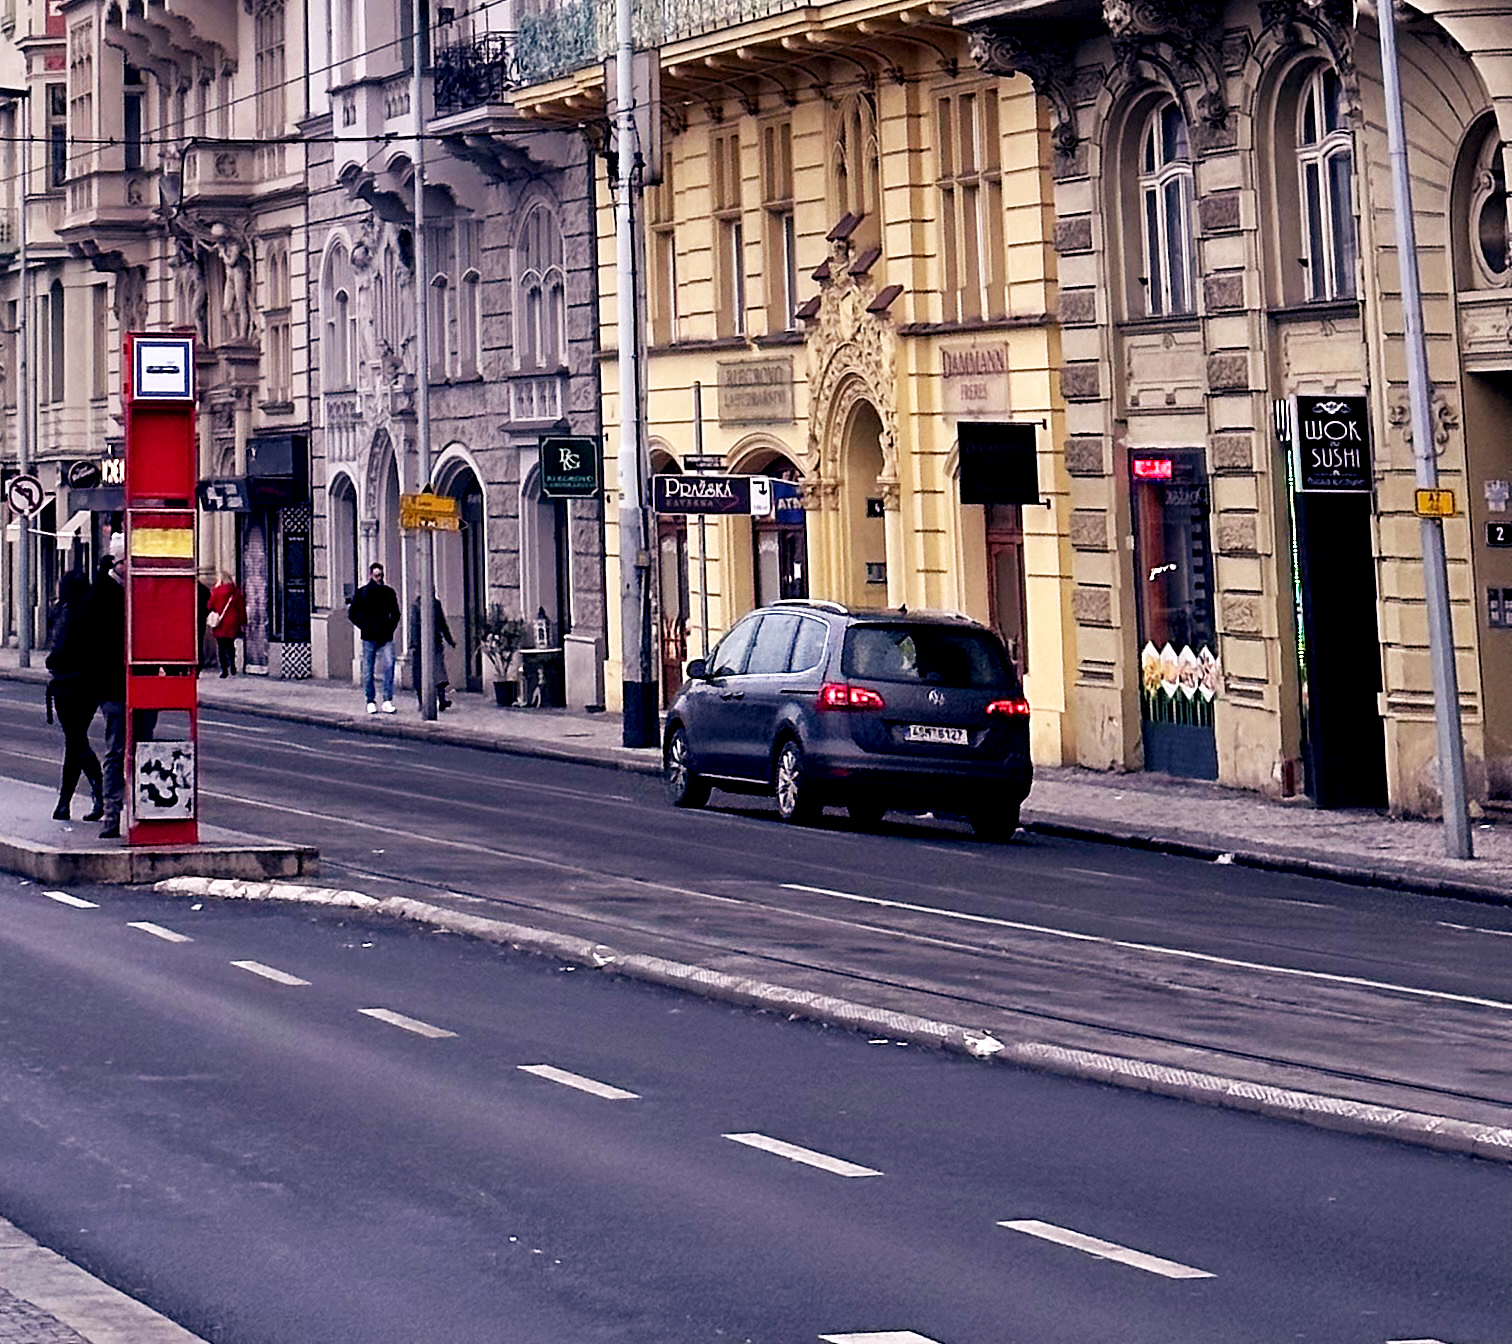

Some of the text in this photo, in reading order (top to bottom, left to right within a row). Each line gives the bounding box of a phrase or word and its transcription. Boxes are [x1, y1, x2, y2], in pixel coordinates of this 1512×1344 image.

[943, 348, 1005, 378] DAMMANN
[1304, 420, 1362, 441] WOK
[1311, 448, 1361, 468] SUSHI
[1495, 526, 1505, 541] 2
